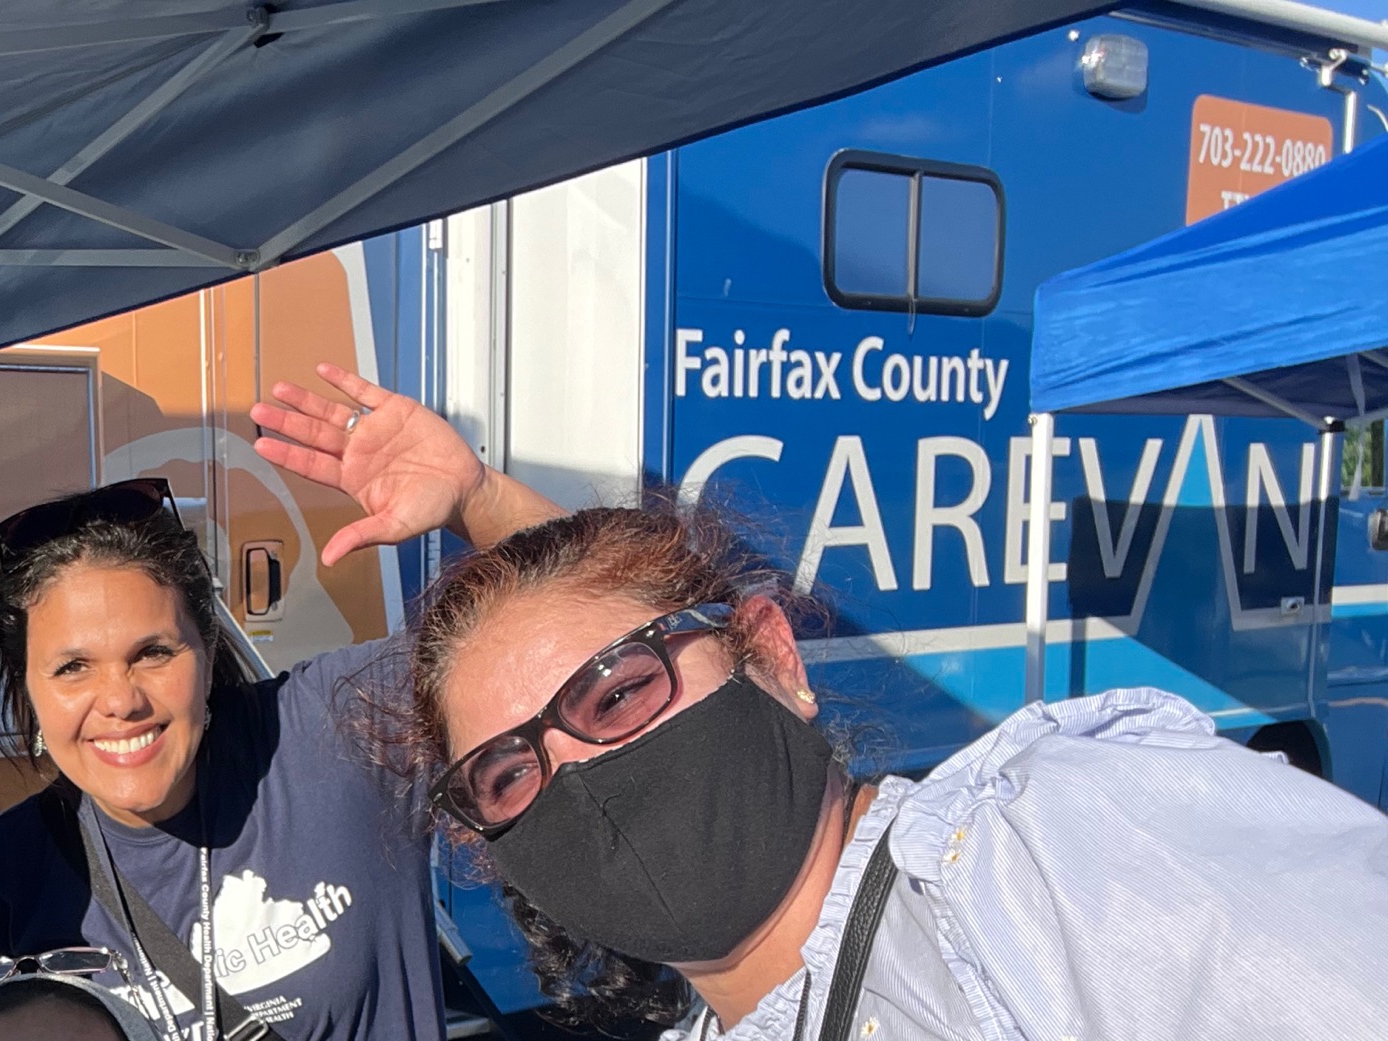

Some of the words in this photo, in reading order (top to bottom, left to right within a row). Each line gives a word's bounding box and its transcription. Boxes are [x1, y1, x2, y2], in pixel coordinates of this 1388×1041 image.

[675, 328, 842, 400] Fairfax
[852, 336, 1009, 421] County
[201, 884, 210, 920] County
[246, 881, 353, 966] Health
[203, 921, 212, 954] Health
[149, 982, 177, 1033] Department
[202, 955, 214, 1010] Department
